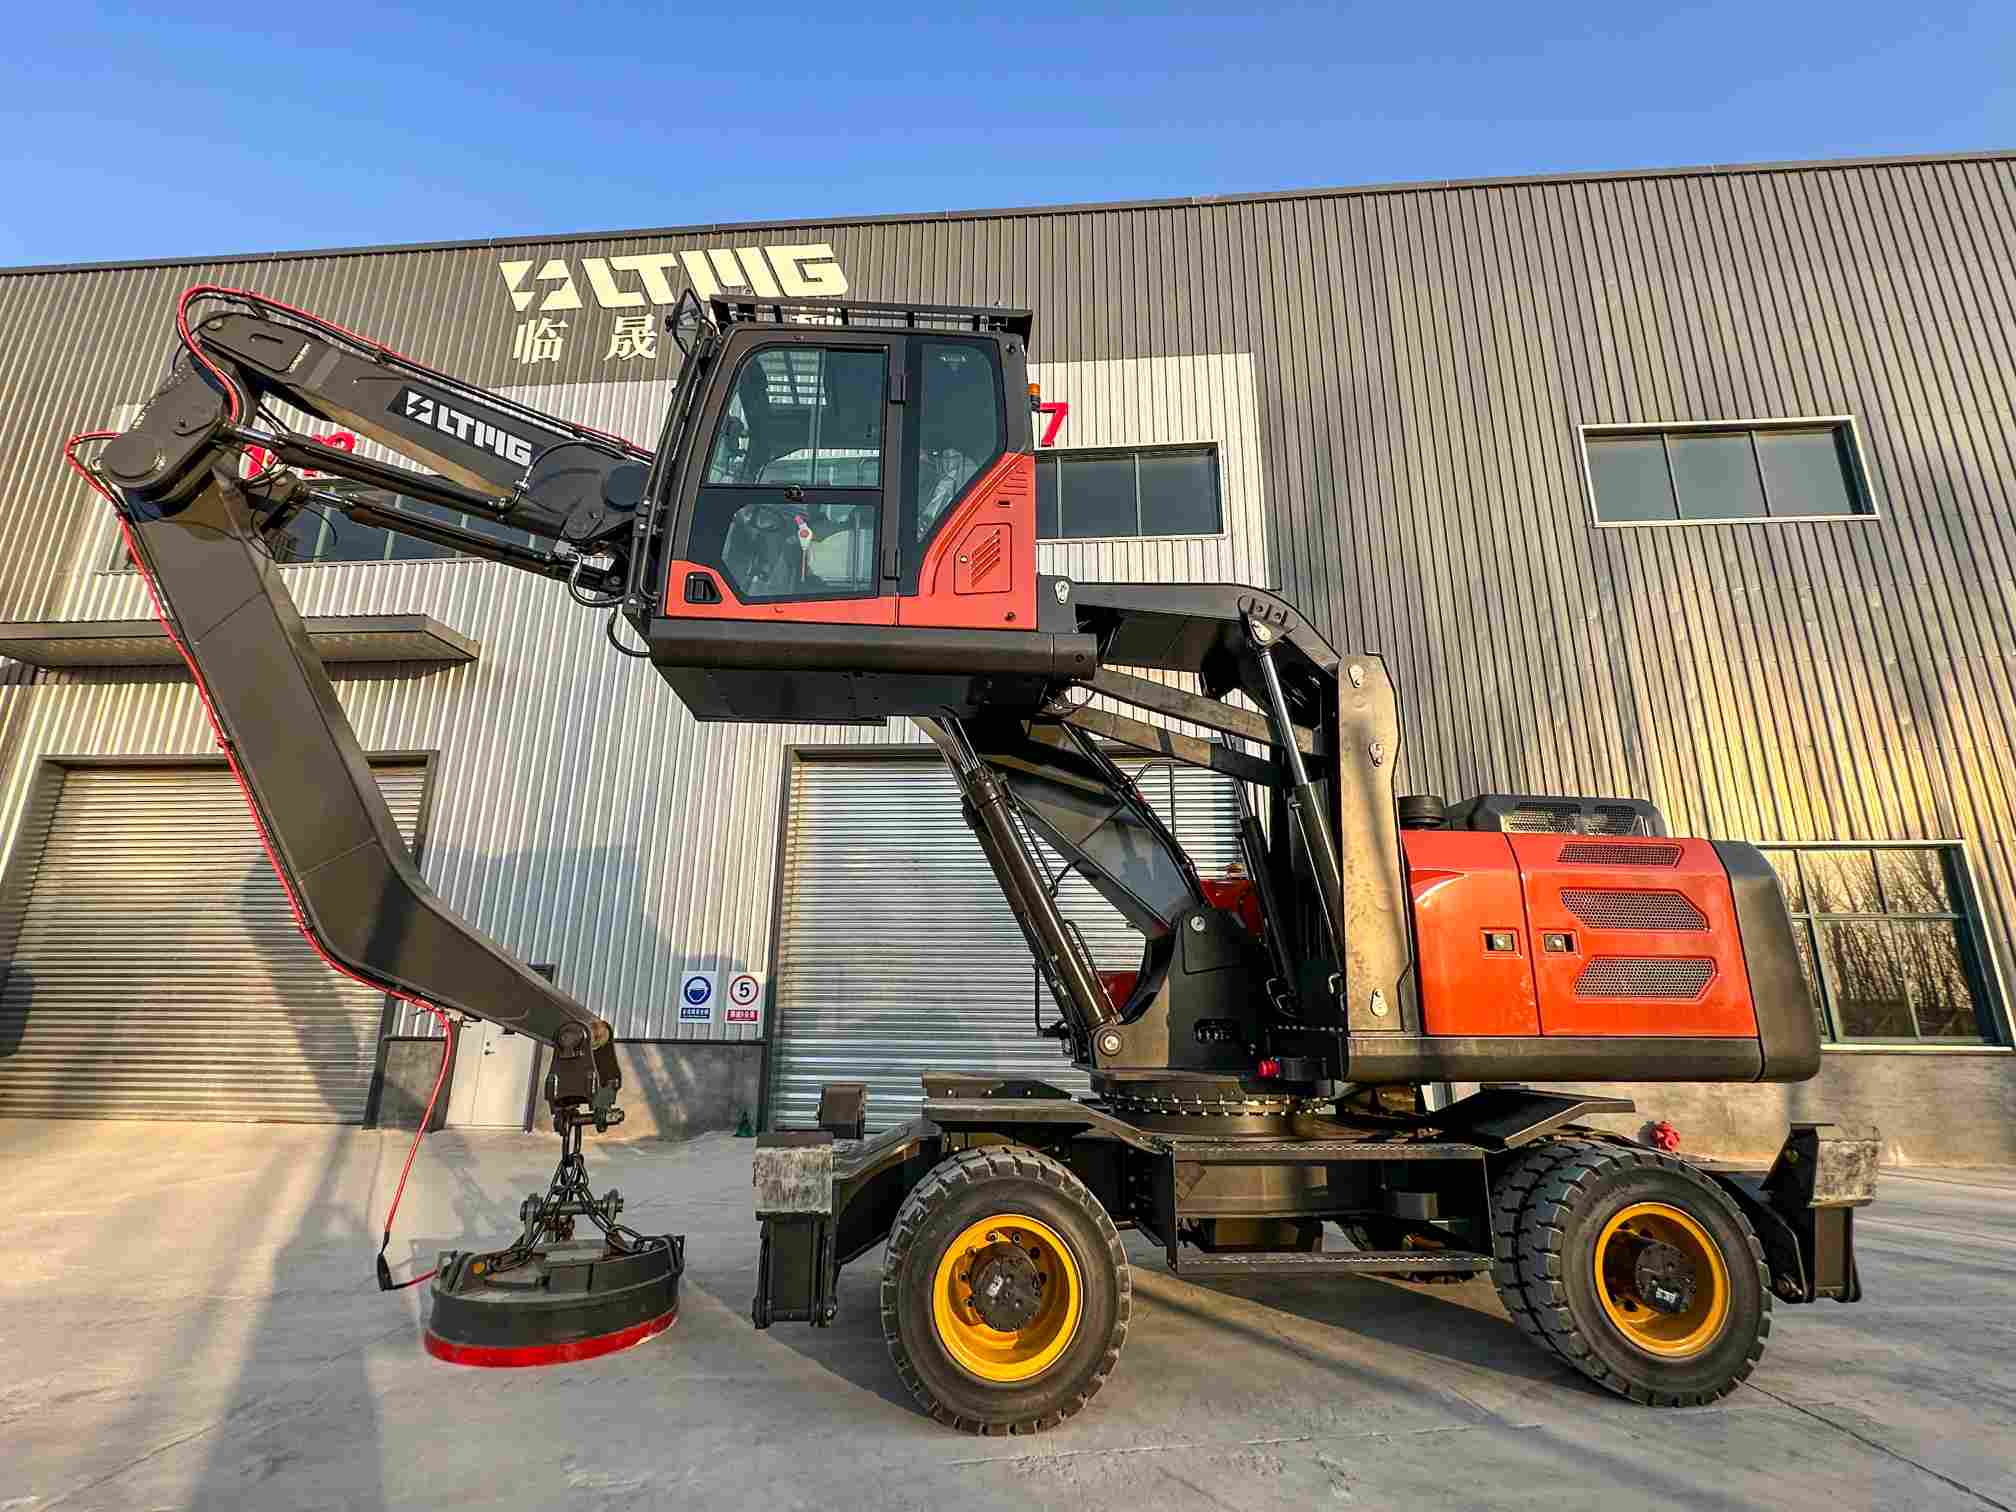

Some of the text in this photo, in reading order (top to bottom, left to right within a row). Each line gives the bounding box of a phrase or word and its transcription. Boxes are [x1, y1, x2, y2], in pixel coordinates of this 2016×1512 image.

[581, 243, 849, 308] LTMG
[436, 403, 533, 466] LTMG
[1039, 402, 1069, 447] 7
[738, 982, 751, 998] 5
